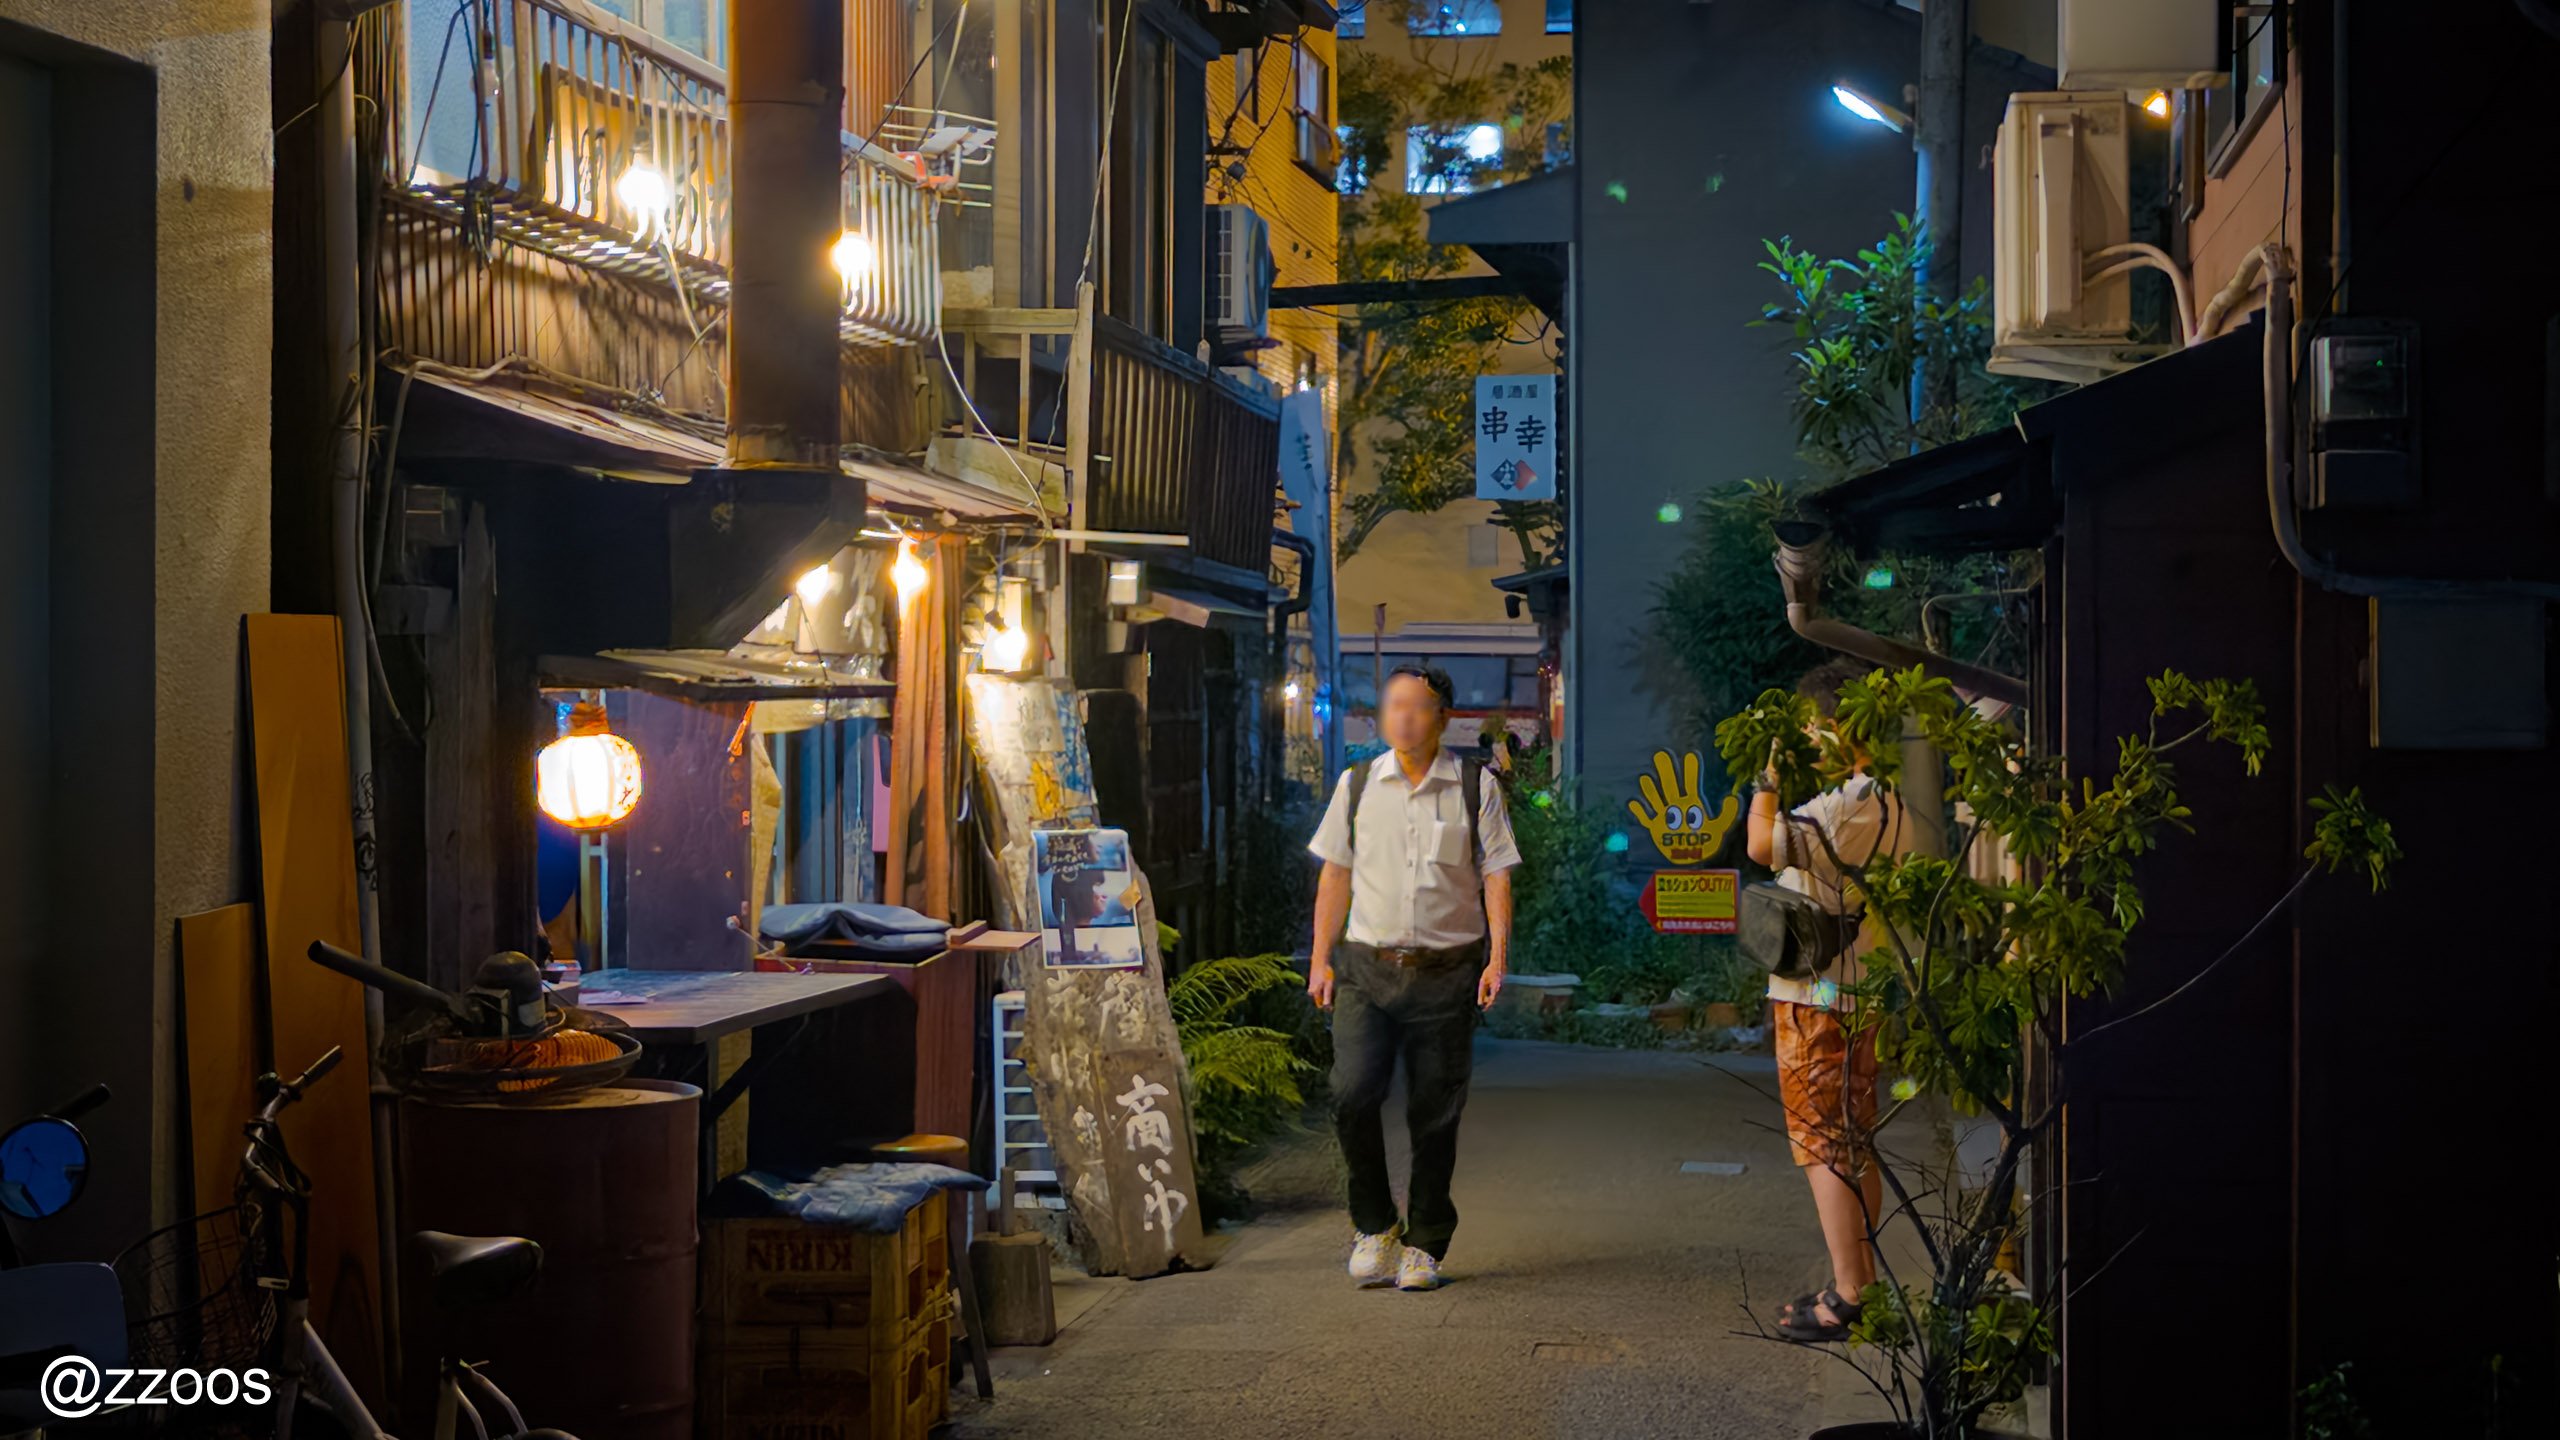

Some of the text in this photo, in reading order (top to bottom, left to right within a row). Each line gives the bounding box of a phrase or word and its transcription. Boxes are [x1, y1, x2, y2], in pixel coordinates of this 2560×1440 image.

[1481, 406, 1546, 454] 串幸
[1662, 832, 1712, 846] STOP
[1115, 1073, 1188, 1252] 商い中
[746, 1239, 853, 1271] KIRIN
